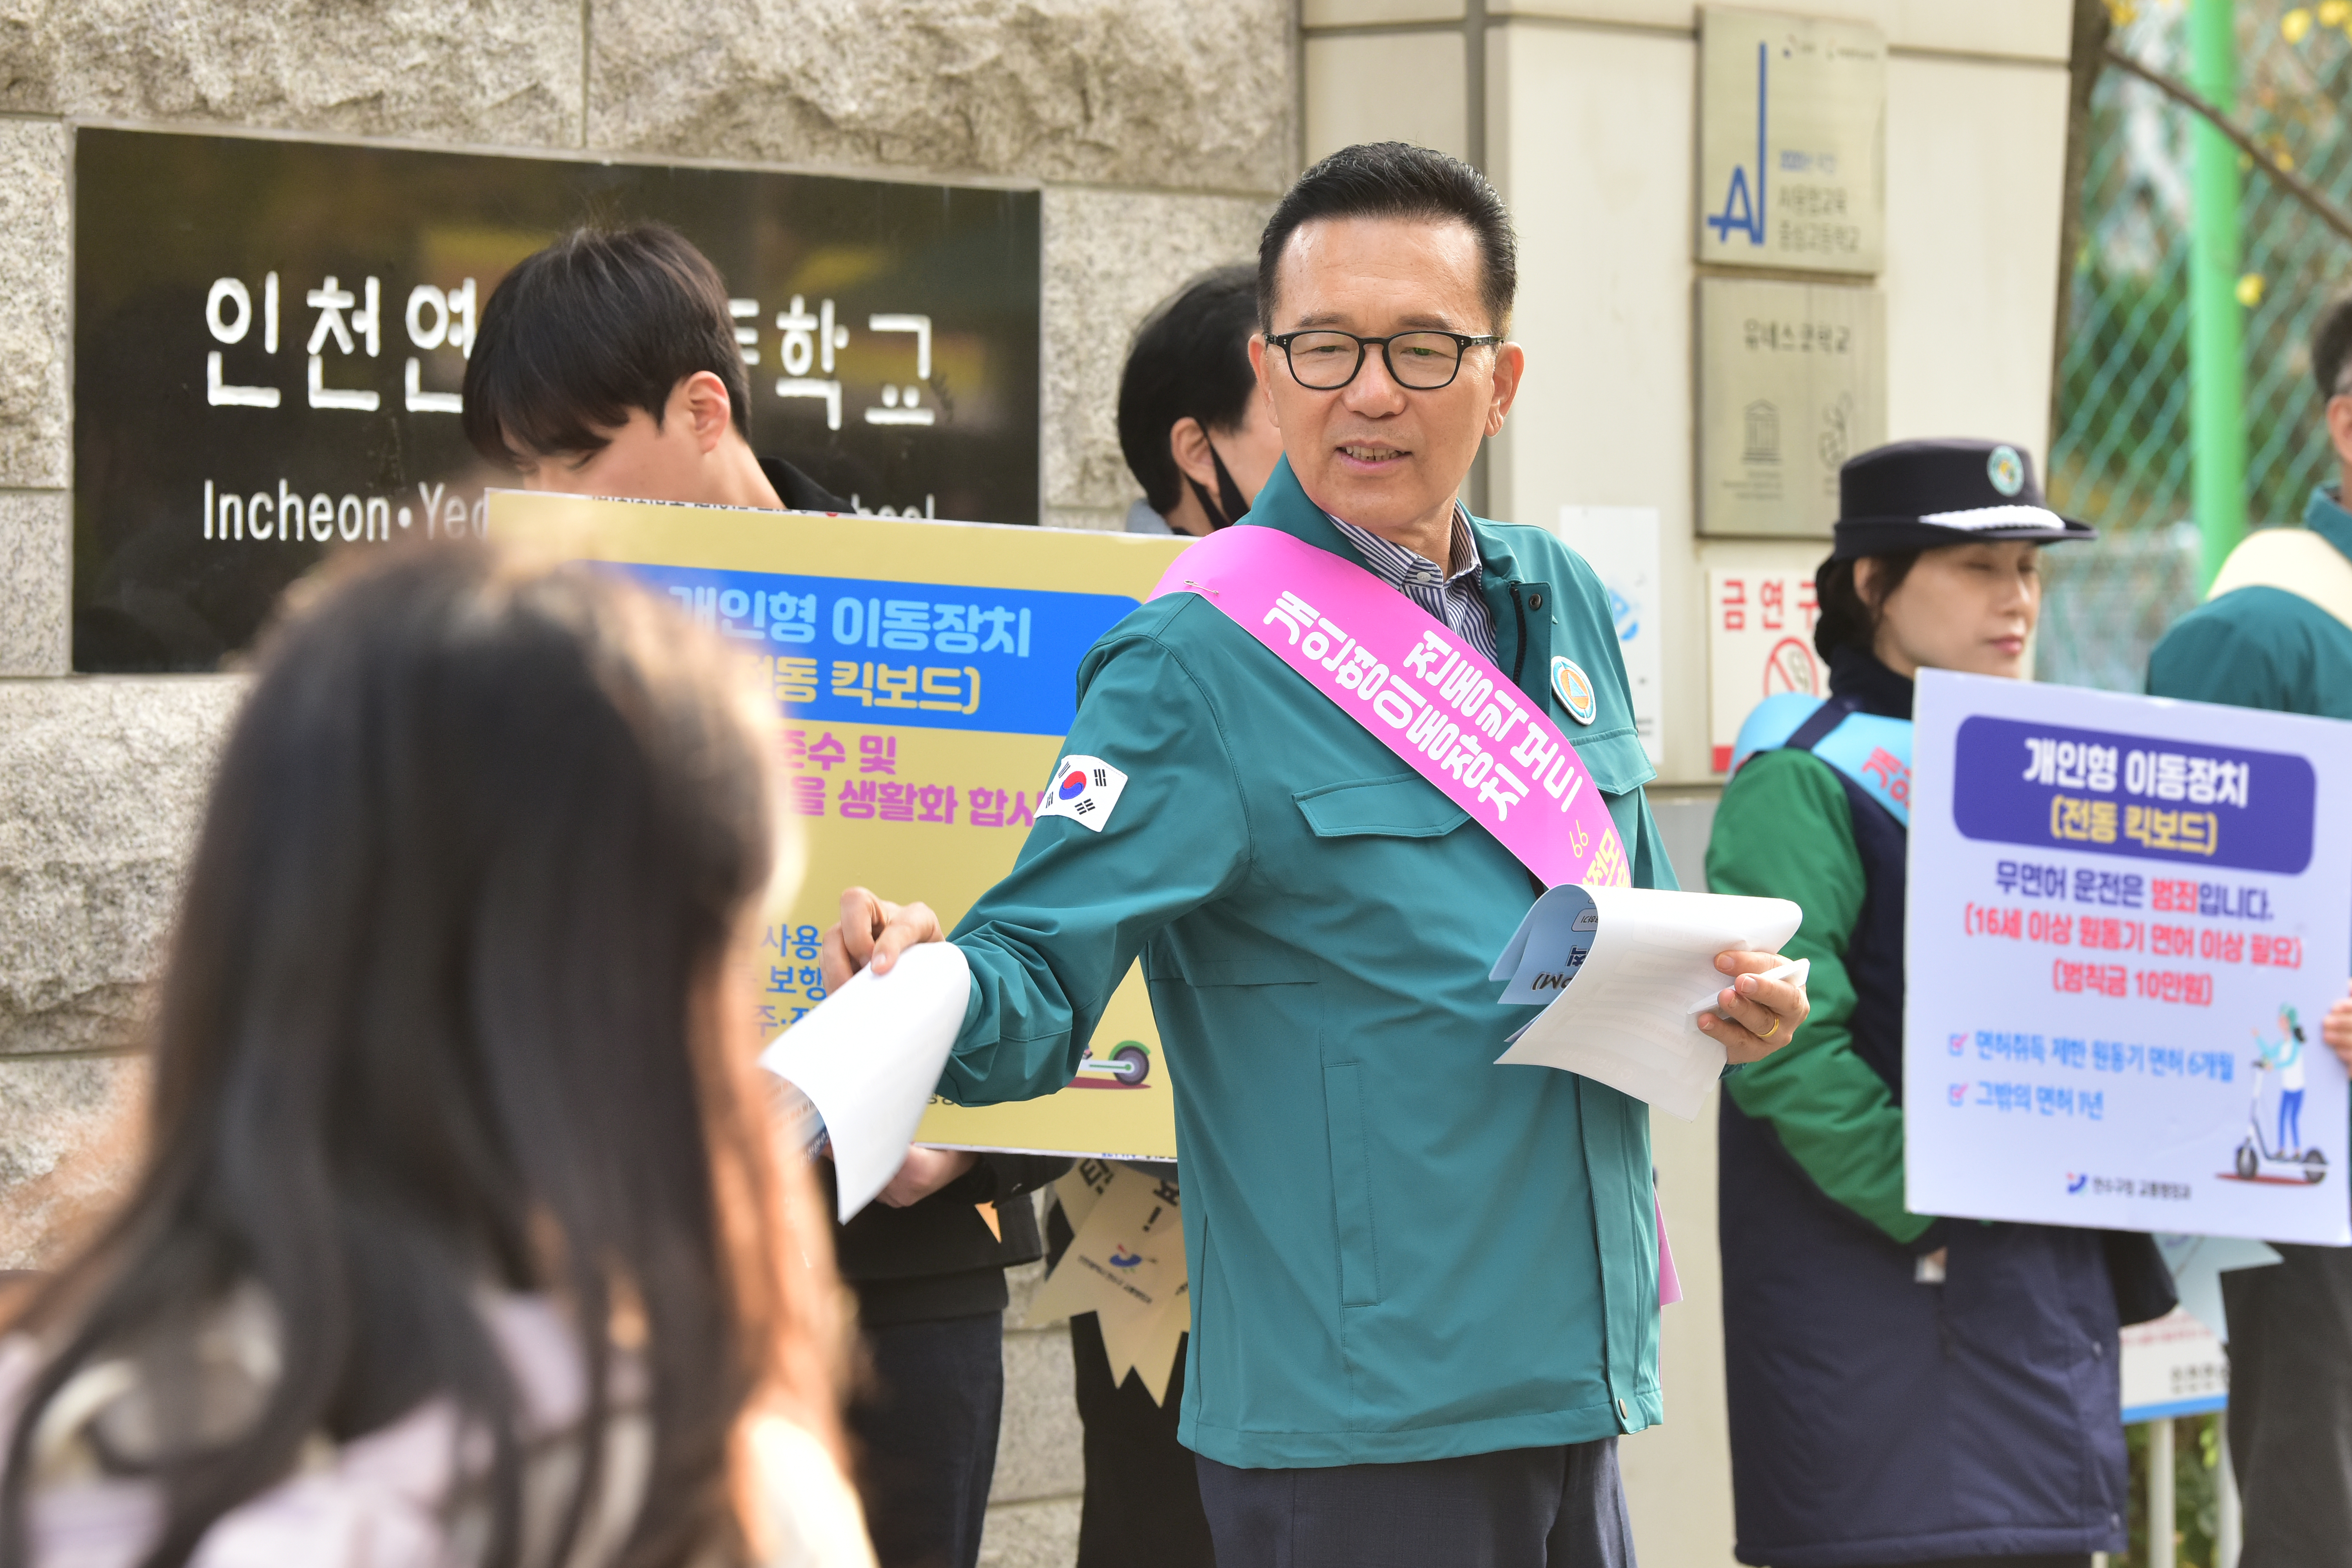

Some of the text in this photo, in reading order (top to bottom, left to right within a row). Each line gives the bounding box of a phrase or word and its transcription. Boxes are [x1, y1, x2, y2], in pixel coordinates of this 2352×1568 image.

[668, 586, 1032, 657] 개인형 이동장치
[1722, 579, 1821, 631] 금연구
[831, 660, 981, 715] 킥보드)
[1263, 590, 1530, 822] 개인형이동장치
[1403, 630, 1583, 813] 전동킥보드
[859, 735, 896, 775] 및
[2022, 737, 2250, 808] 개인형 이동장치
[838, 779, 959, 825] 생활화
[968, 786, 1045, 828] 합시
[2051, 794, 2218, 856] (전동 킥보드)
[1996, 860, 2274, 922] 무면허 운전은 범죄입니다.
[1965, 902, 2303, 969] (16세 이상 원동기 면허 이상 필요)
[2053, 958, 2213, 1007] (범칙금 10만원)
[2149, 1045, 2185, 1077] 면허
[2037, 1085, 2074, 1117] 면허
